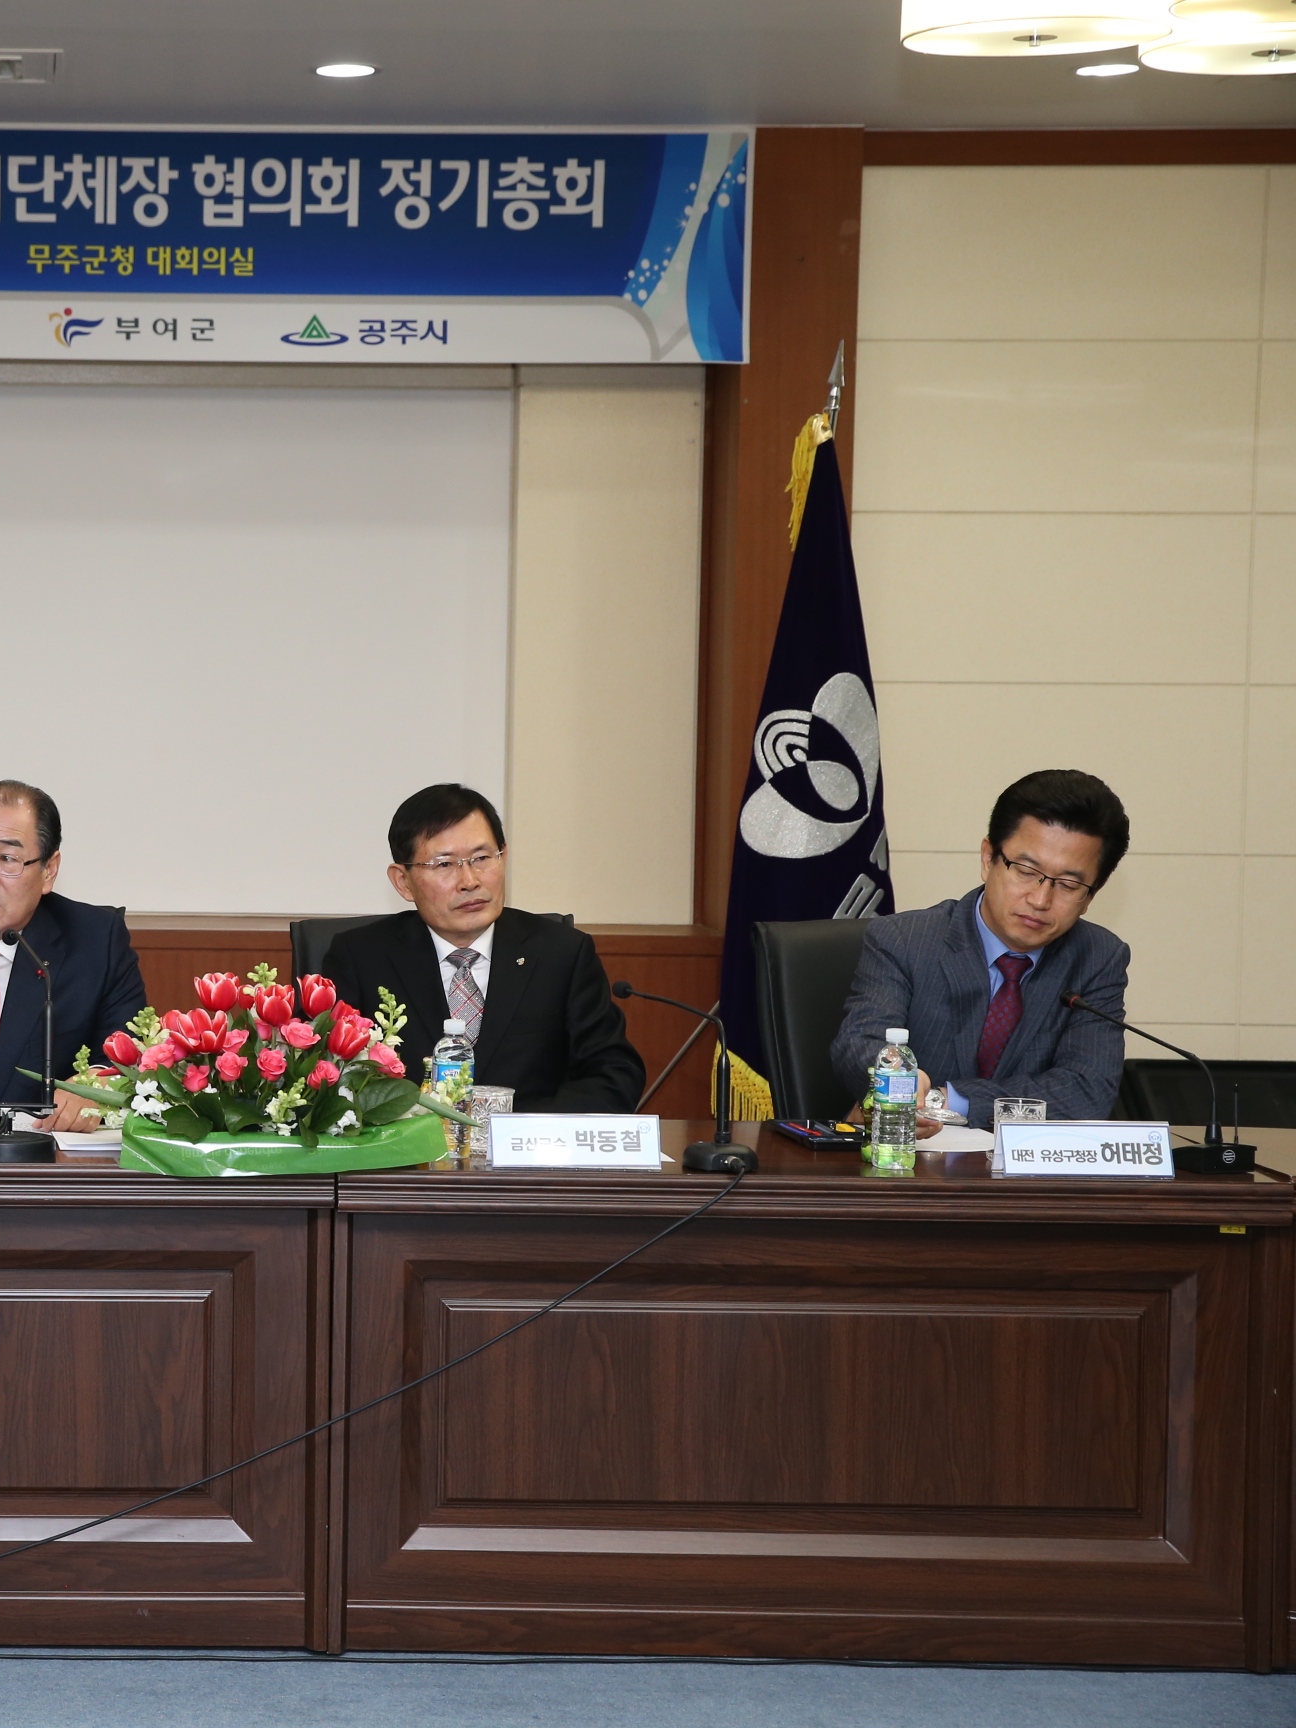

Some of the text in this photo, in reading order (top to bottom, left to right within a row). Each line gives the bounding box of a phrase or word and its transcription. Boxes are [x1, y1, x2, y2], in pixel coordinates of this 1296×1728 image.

[191, 155, 361, 229] 협의회
[378, 158, 607, 230] 정기총회
[26, 245, 135, 277] 무주군청
[147, 245, 256, 277] 대회의실
[114, 317, 216, 343] 부여군
[357, 318, 450, 346] 공주시
[574, 1130, 643, 1152] 박동철
[1011, 1142, 1164, 1166] 대전 유성구청장 허태정
